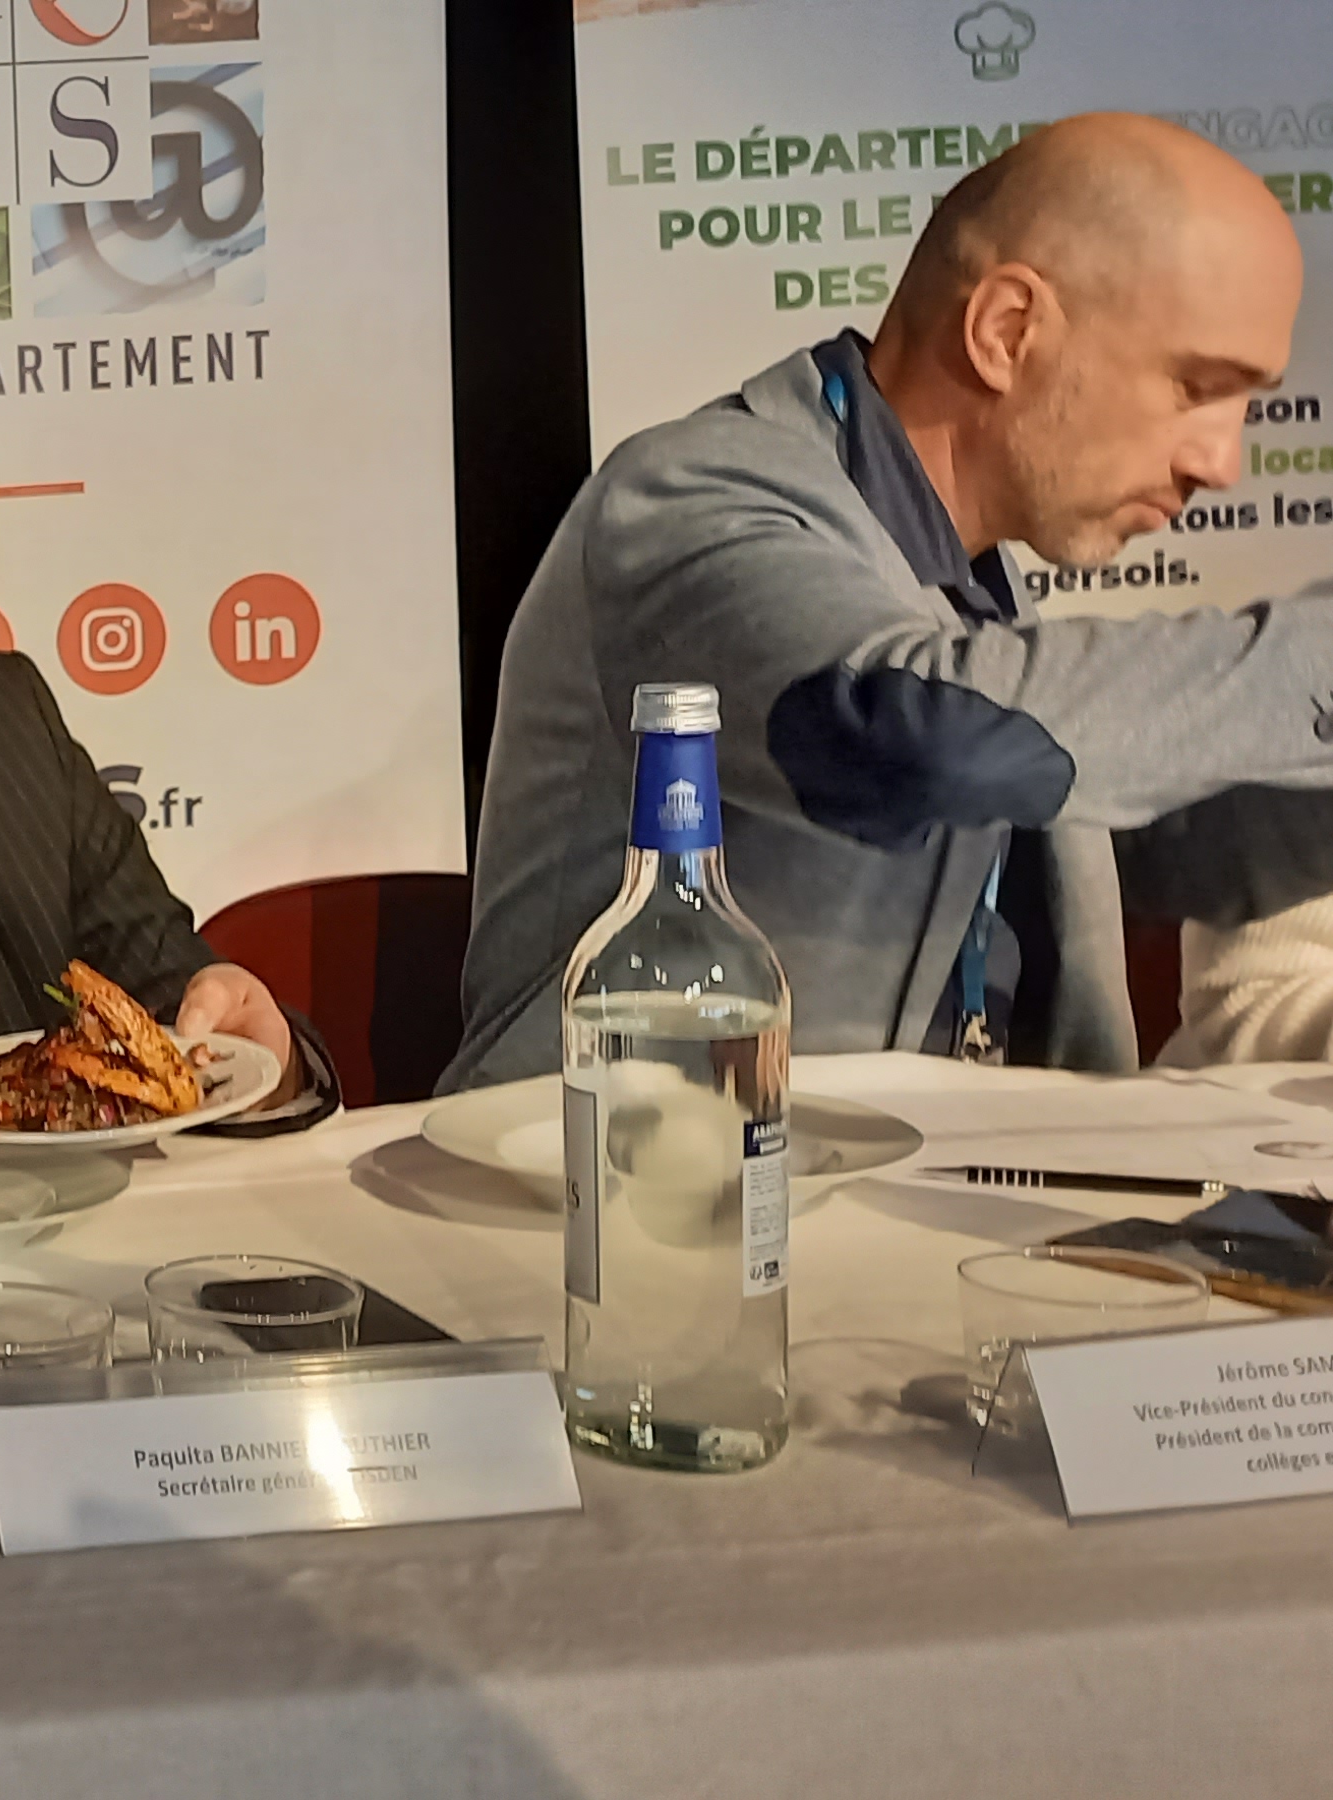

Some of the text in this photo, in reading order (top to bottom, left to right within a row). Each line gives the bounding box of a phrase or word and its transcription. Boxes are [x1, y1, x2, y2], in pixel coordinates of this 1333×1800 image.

[606, 142, 677, 187] LE
[694, 121, 1052, 183] DÉPARTEM
[658, 202, 823, 251] POUR
[842, 194, 913, 241] LE
[774, 263, 890, 311] DES
[1244, 394, 1321, 425] son
[1250, 441, 1333, 477] loca
[1273, 490, 1333, 528] les
[234, 599, 297, 663] in
[1217, 1354, 1333, 1383] Jérôme SAM
[1133, 1389, 1333, 1422] Vice-Président du con
[133, 1431, 432, 1470] Paquita BANNIE UTHIER
[1155, 1419, 1333, 1451] Président de la com
[1246, 1450, 1321, 1474] collèges
[157, 1470, 257, 1498] Secrétaire
[262, 1468, 319, 1494] génér
